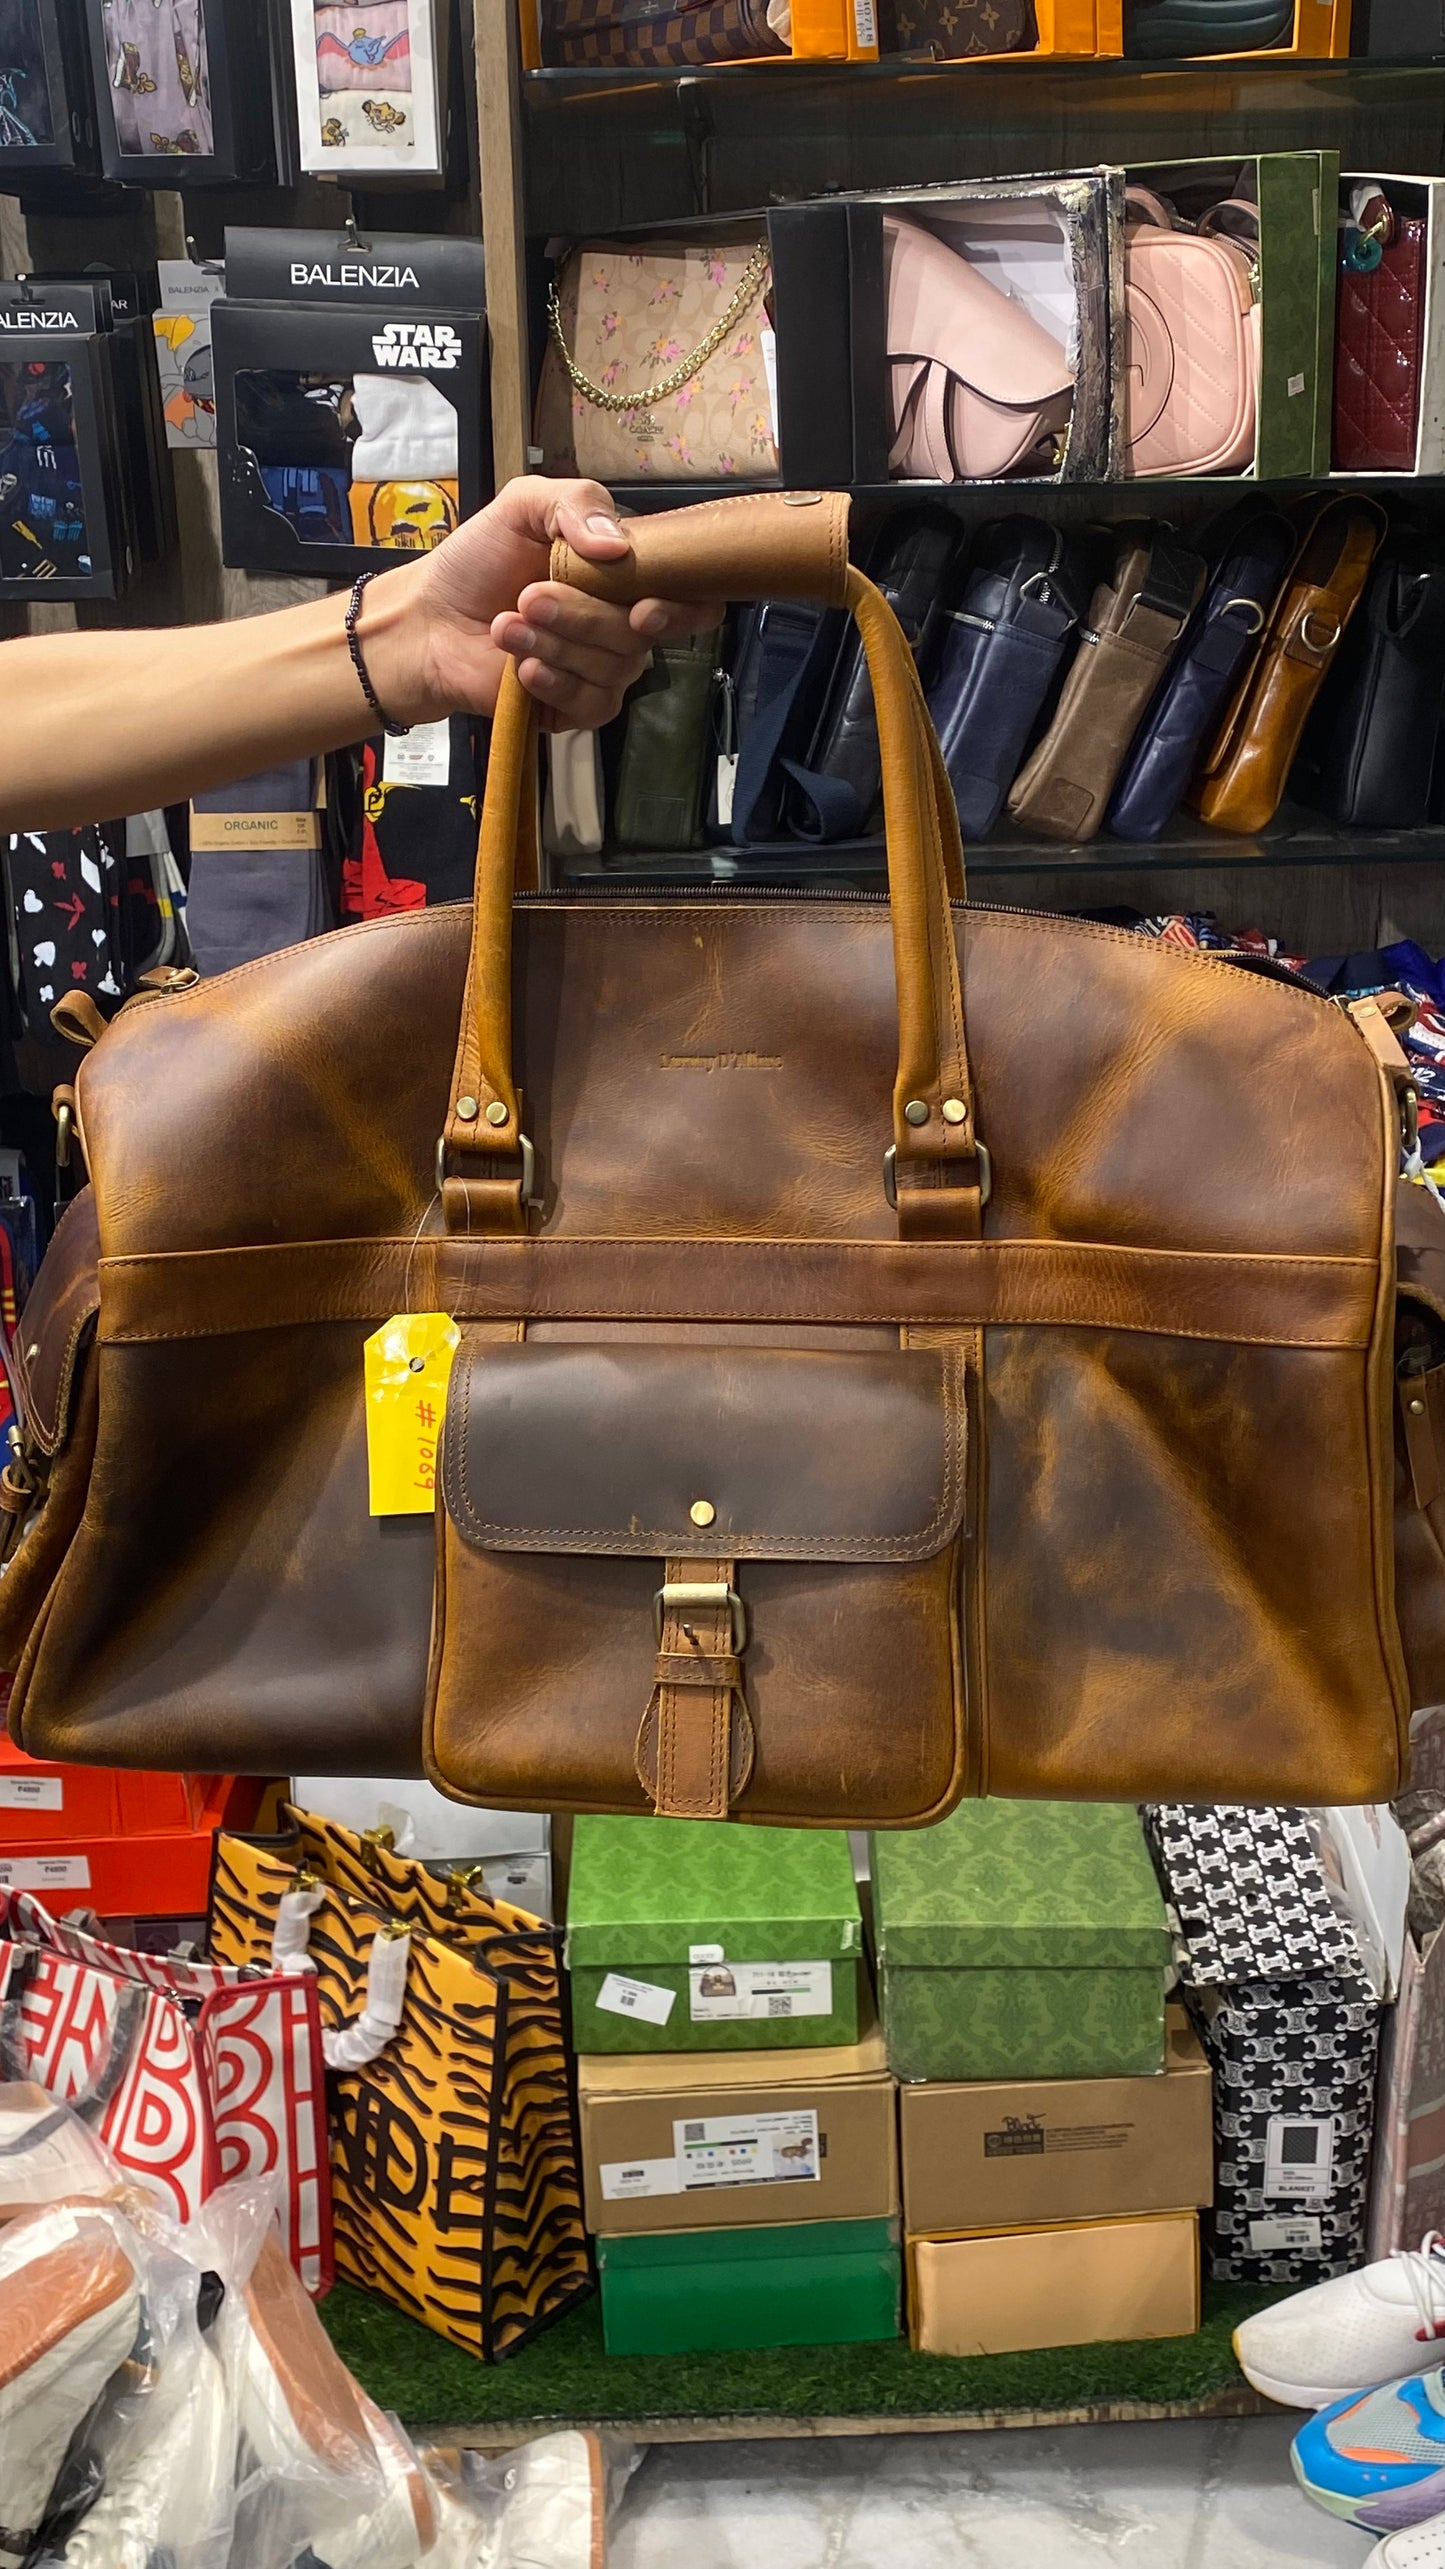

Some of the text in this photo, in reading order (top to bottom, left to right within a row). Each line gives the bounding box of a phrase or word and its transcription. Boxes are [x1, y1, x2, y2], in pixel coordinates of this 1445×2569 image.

[290, 263, 420, 288] BALENZIA
[168, 286, 209, 295] BALENZIA
[0, 312, 79, 329] LENZIA
[372, 323, 462, 348] STAR
[372, 344, 462, 369] WARS
[224, 820, 278, 831] ORGANIC
[413, 1399, 437, 1490] #1069
